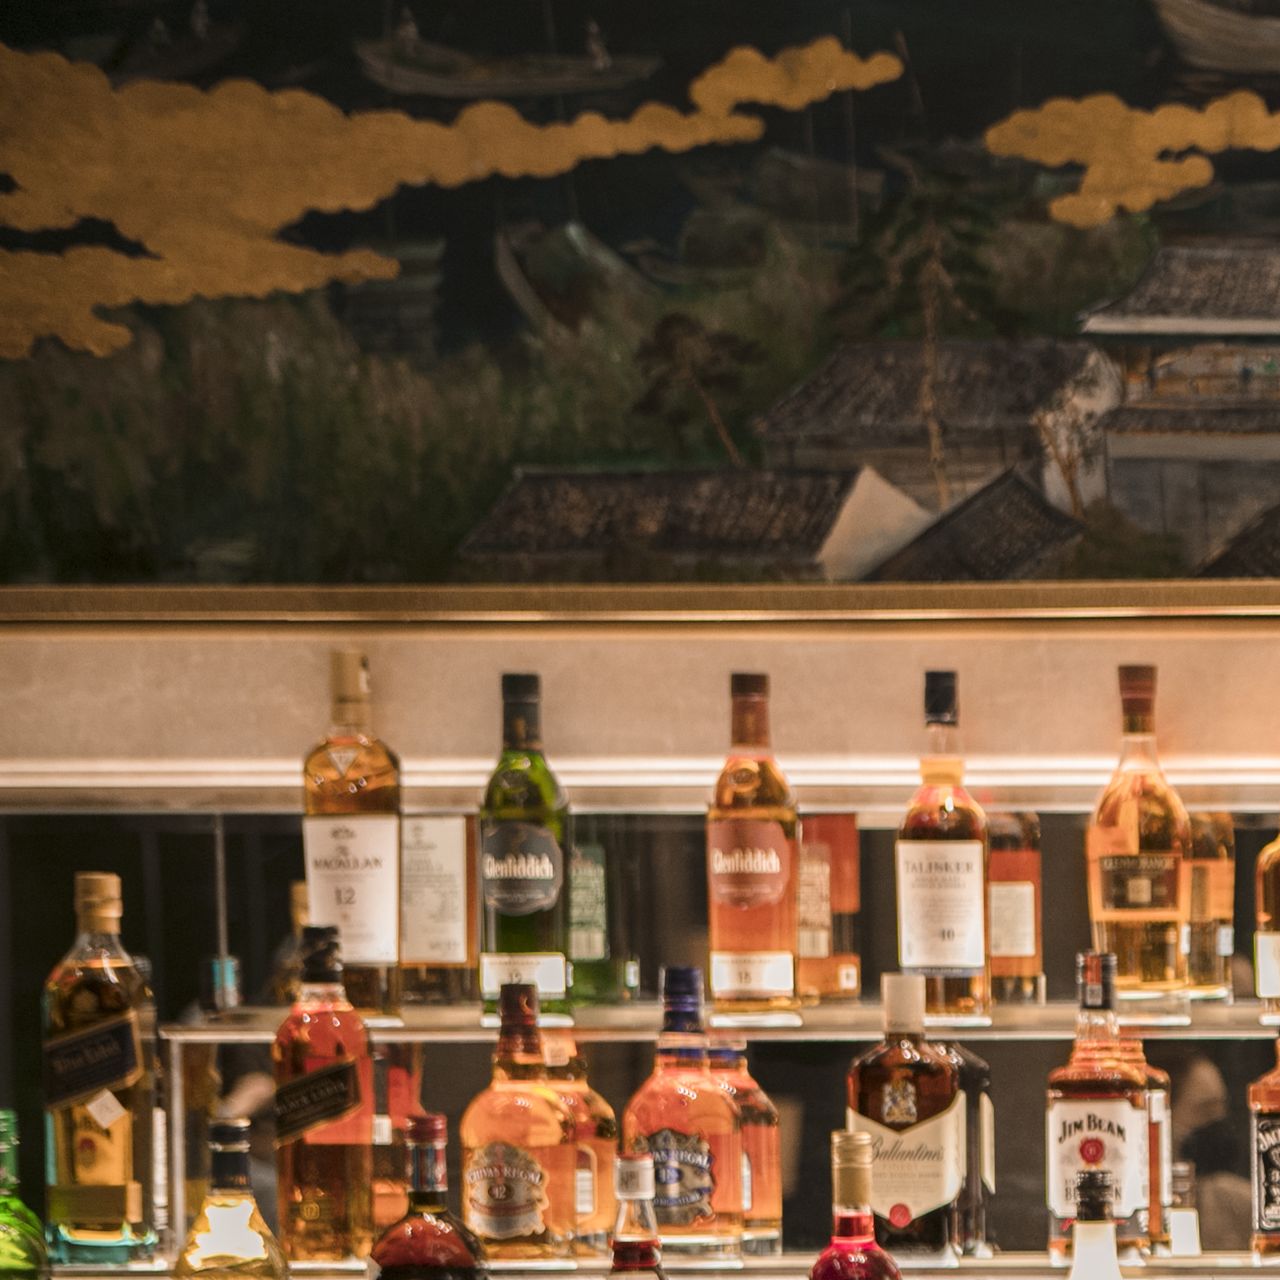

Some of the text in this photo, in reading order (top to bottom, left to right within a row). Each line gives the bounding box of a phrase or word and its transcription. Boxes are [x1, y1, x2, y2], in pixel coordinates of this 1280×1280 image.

[483, 852, 554, 880] Glenfiddich
[712, 848, 781, 874] Glenfiddich
[334, 886, 357, 906] 12
[940, 928, 956, 941] 10
[1058, 1120, 1084, 1144] JIM
[466, 1166, 542, 1185] CHIVAS REGAL
